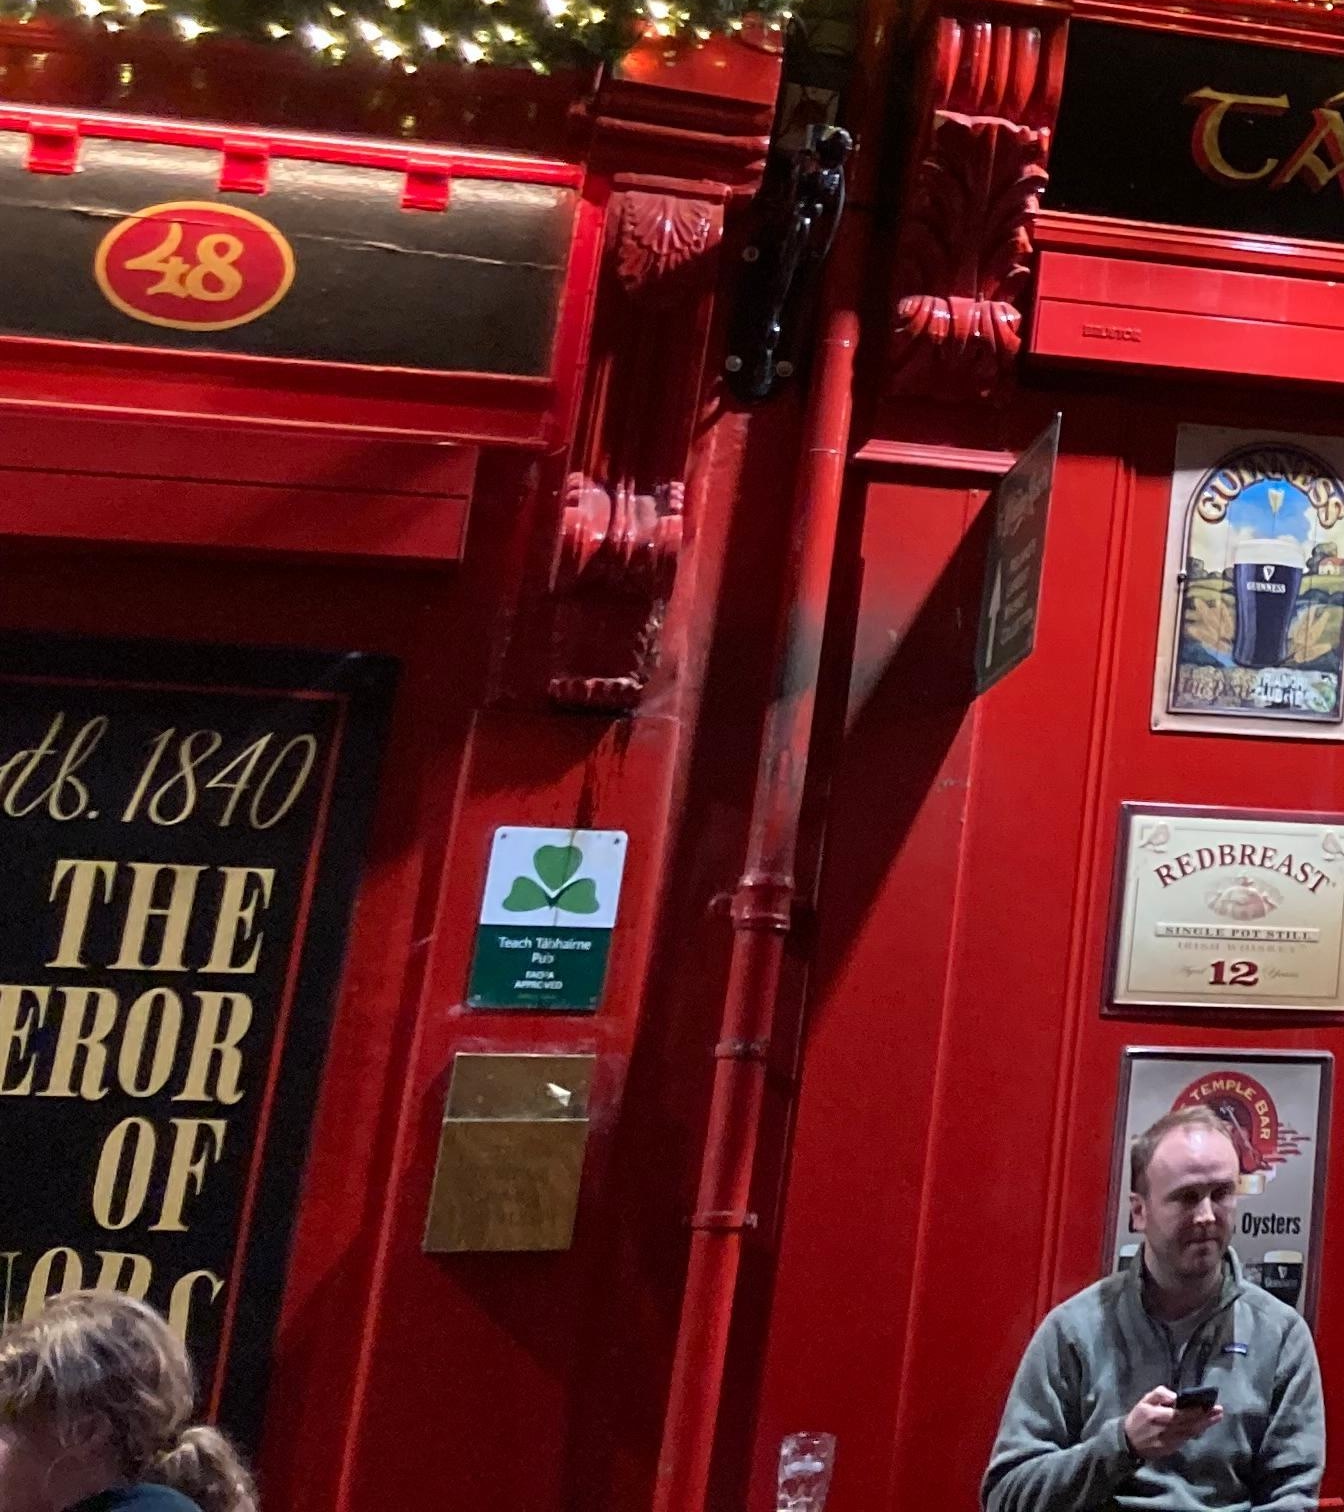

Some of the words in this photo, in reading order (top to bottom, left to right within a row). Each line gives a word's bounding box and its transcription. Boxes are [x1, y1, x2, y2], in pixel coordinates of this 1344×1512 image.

[125, 223, 244, 302] 48
[1198, 453, 1344, 528] GUINNESS
[122, 729, 317, 829] 1840
[1154, 844, 1330, 893] REDBREAST
[45, 859, 276, 974] THE
[499, 936, 532, 949] Teach
[1231, 928, 1262, 938] POT
[1265, 930, 1312, 940] STILL
[532, 952, 554, 963] Pub
[1208, 961, 1260, 986] 12
[1190, 1079, 1256, 1100] TEMPLE
[1255, 1099, 1271, 1141] BAR
[93, 1116, 227, 1232] OF
[1241, 1211, 1301, 1238] Oysters
